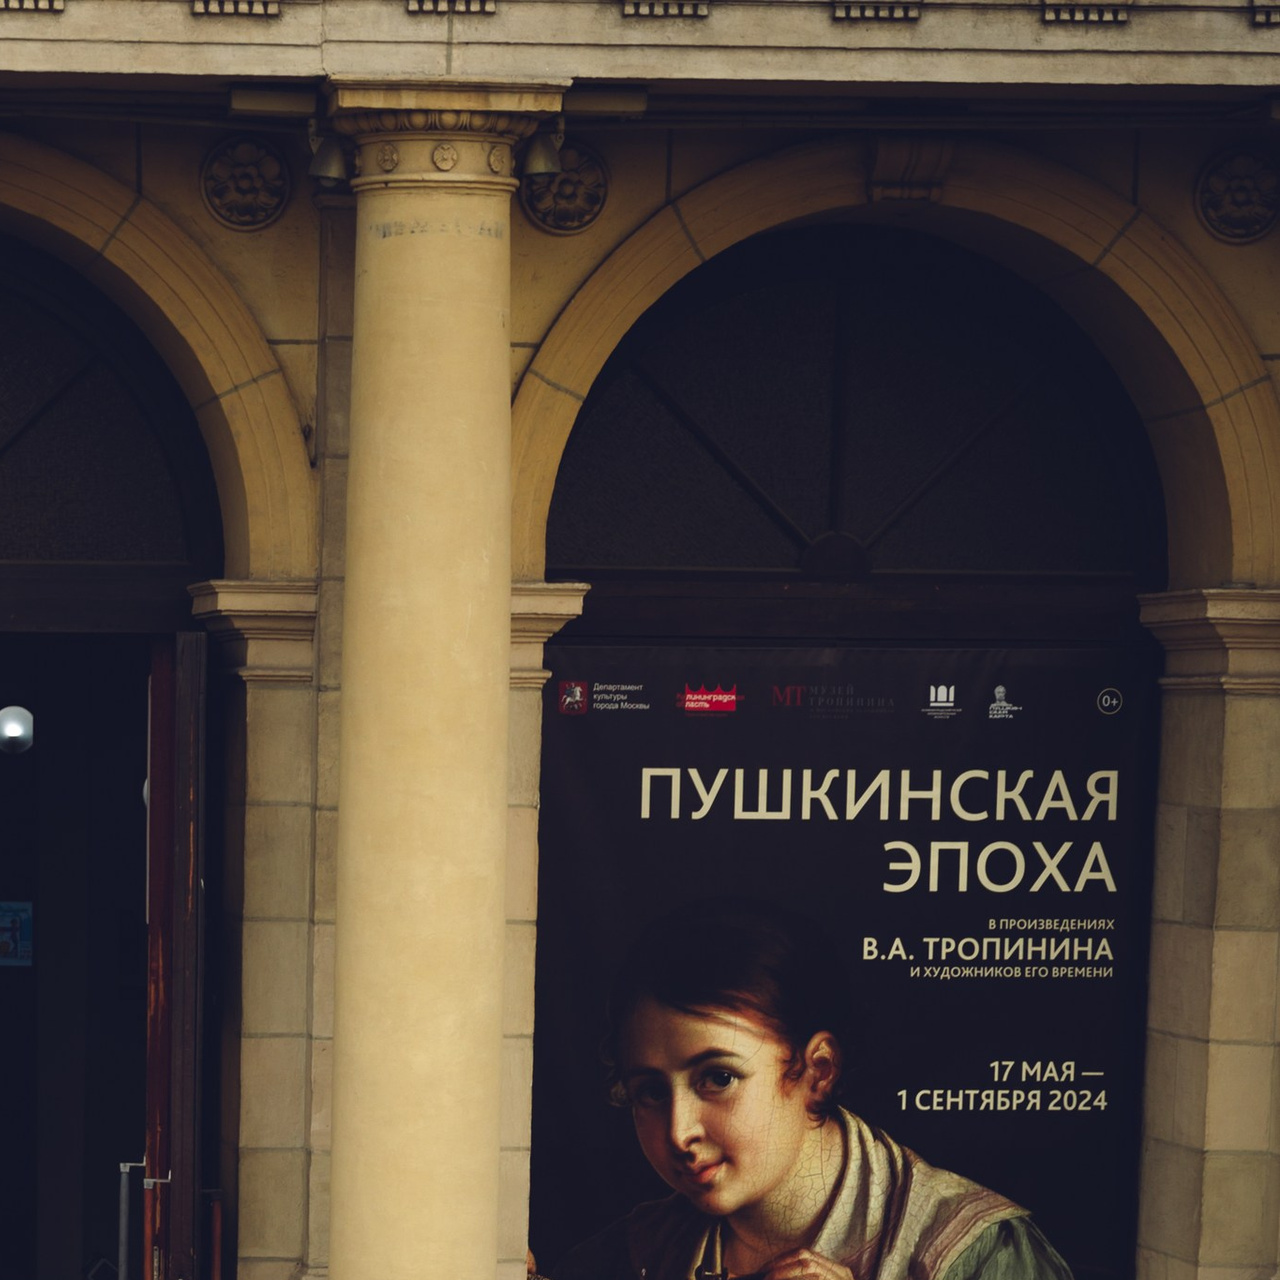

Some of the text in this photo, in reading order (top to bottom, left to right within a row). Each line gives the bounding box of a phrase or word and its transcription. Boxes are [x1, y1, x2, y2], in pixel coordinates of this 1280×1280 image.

[593, 682, 644, 692] Департамент
[593, 693, 628, 702] культуры
[1102, 695, 1119, 708] 0+
[593, 701, 650, 711] города Москвы
[640, 767, 1119, 822] ПУШКИНСКАЯ
[882, 840, 1118, 894] ЭПОХА
[988, 919, 1115, 933] В ПРОИЗВЕДЕНИЯХ
[862, 937, 1114, 961] В.А. ТРОПИНИНА
[910, 966, 1113, 980] И ХУДОЖНИКОВ ЕГО ВРЕМЕНИ
[989, 1061, 1015, 1082] 17
[1021, 1061, 1075, 1082] МАЯ
[897, 1089, 1108, 1111] 1 СЕНТЯБРЯ 2024
